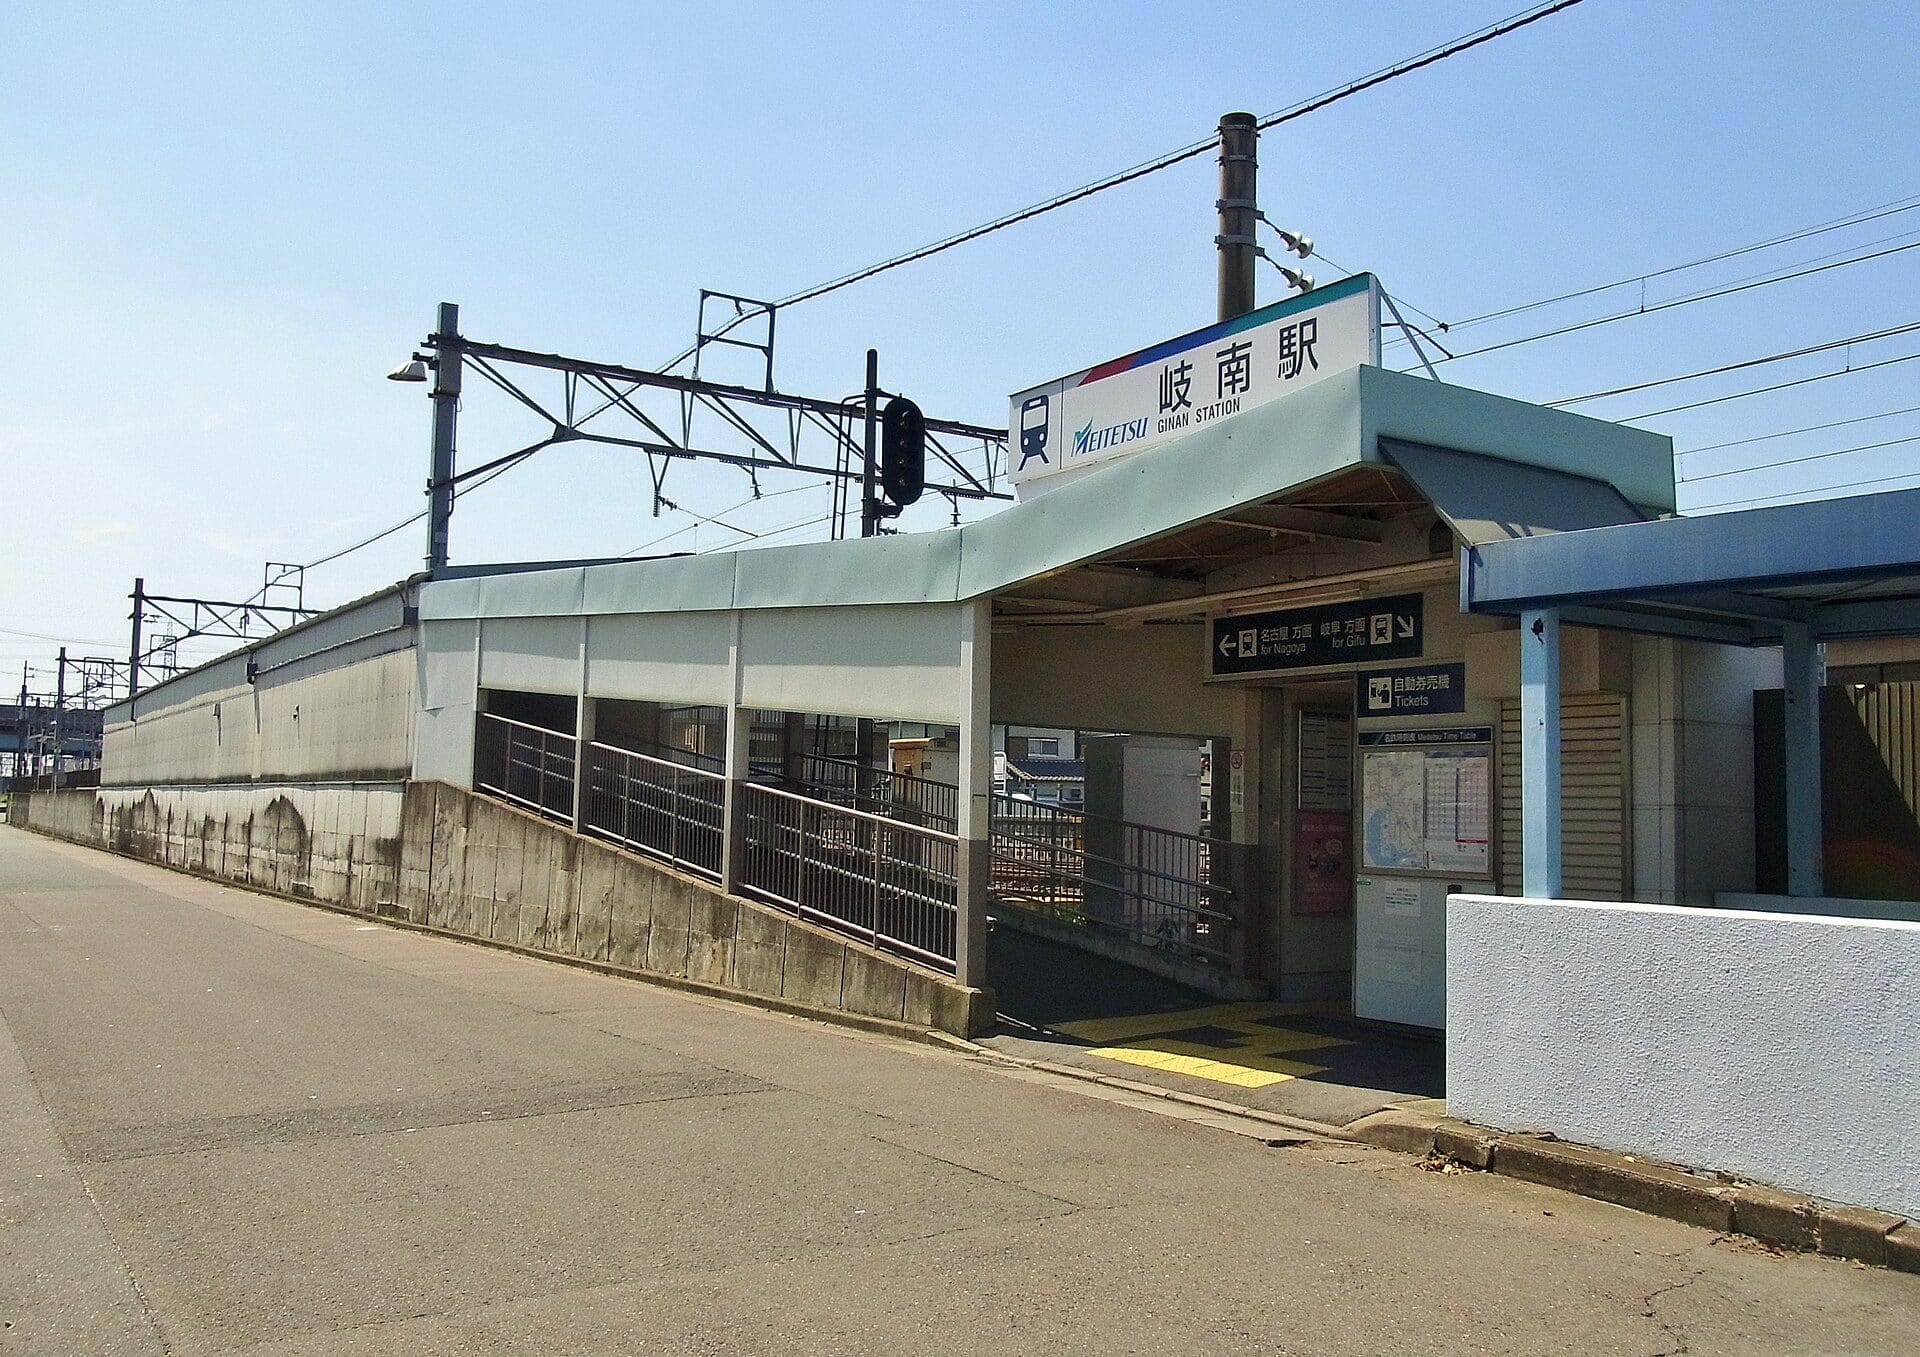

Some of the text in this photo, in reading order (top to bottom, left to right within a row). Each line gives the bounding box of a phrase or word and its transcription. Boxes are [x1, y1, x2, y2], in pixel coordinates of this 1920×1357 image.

[1159, 317, 1319, 414] 岐南駅
[1157, 397, 1240, 433] GINAN STATION
[1071, 416, 1148, 457] MEITETSU
[1292, 623, 1312, 639] 方面
[1345, 618, 1366, 633] 方面
[1261, 642, 1306, 656] for Nagoya
[1332, 635, 1366, 648] for Gifu
[1394, 674, 1450, 692] 自動券売機
[1394, 695, 1429, 707] Tickets
